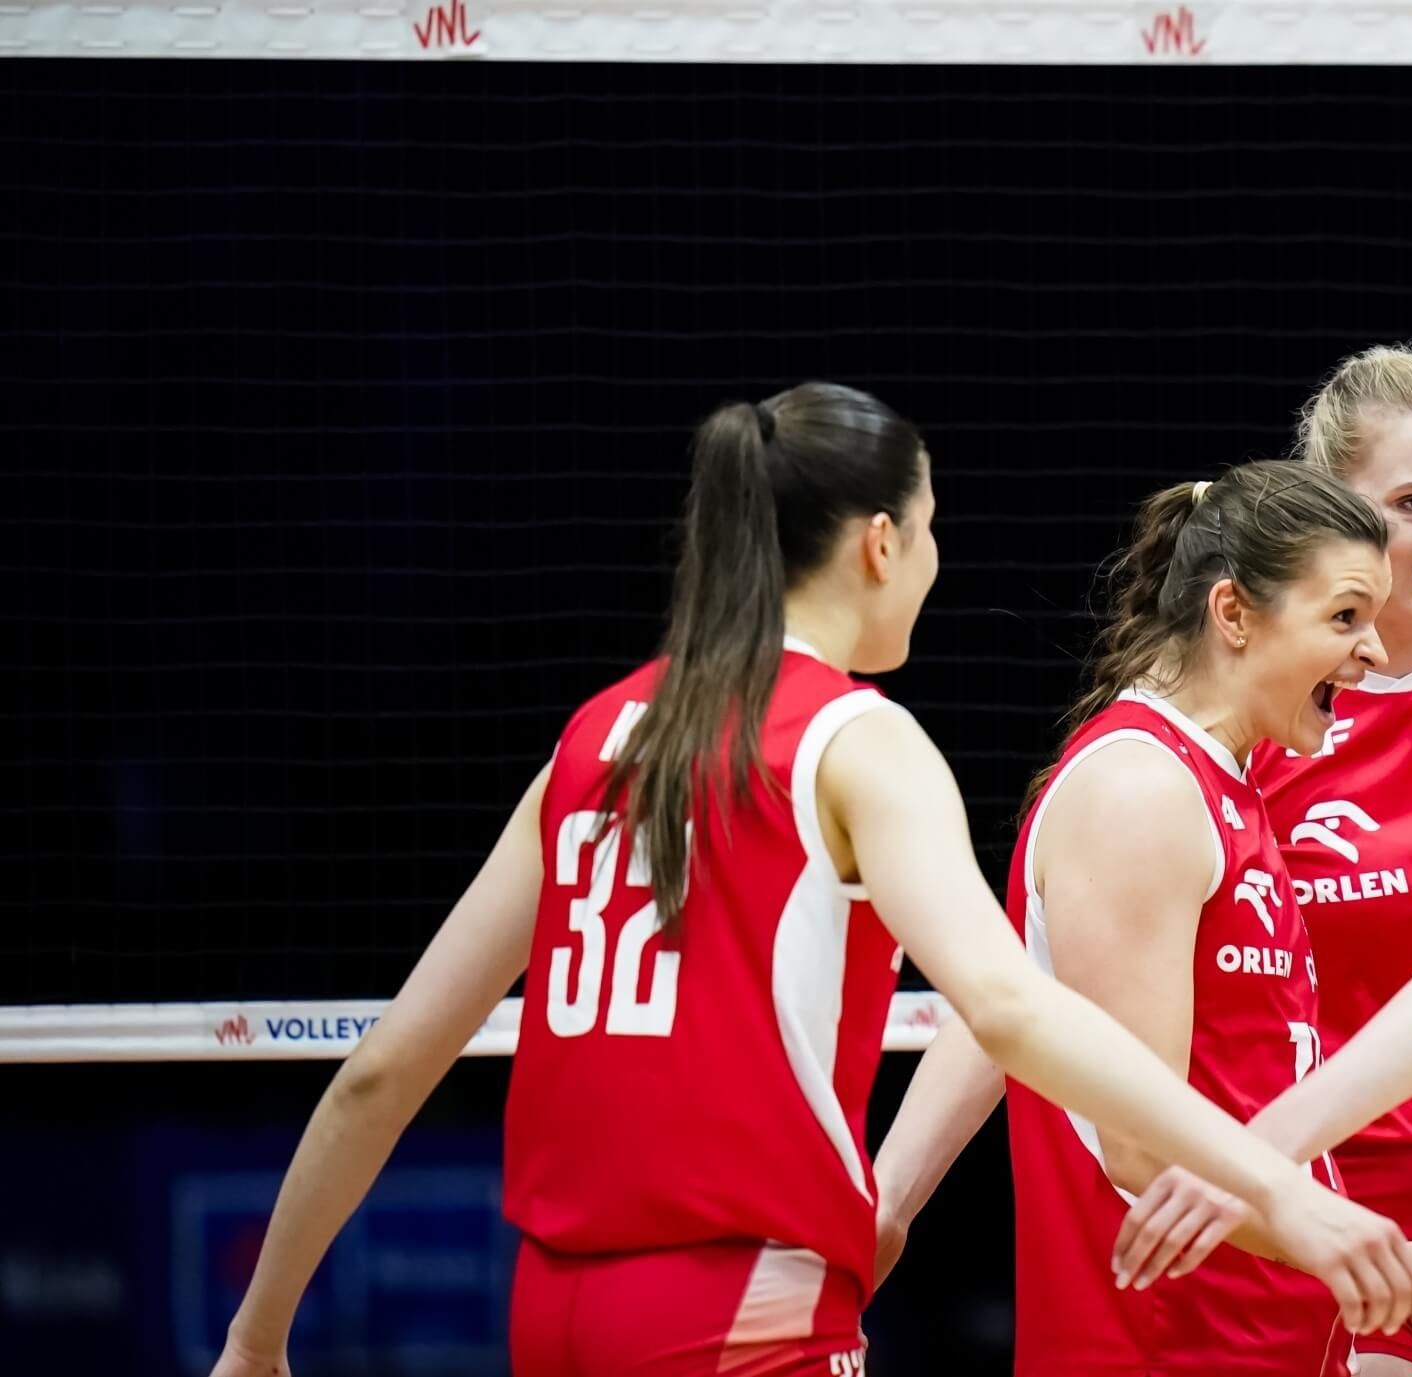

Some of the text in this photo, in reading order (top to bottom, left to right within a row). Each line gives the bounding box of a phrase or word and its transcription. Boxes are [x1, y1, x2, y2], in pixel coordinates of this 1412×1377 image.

[413, 0, 482, 49] VNL
[1141, 4, 1207, 56] VNL
[1292, 868, 1409, 906] ORLEN
[546, 810, 694, 1038] 32
[1216, 944, 1293, 979] ORLEN
